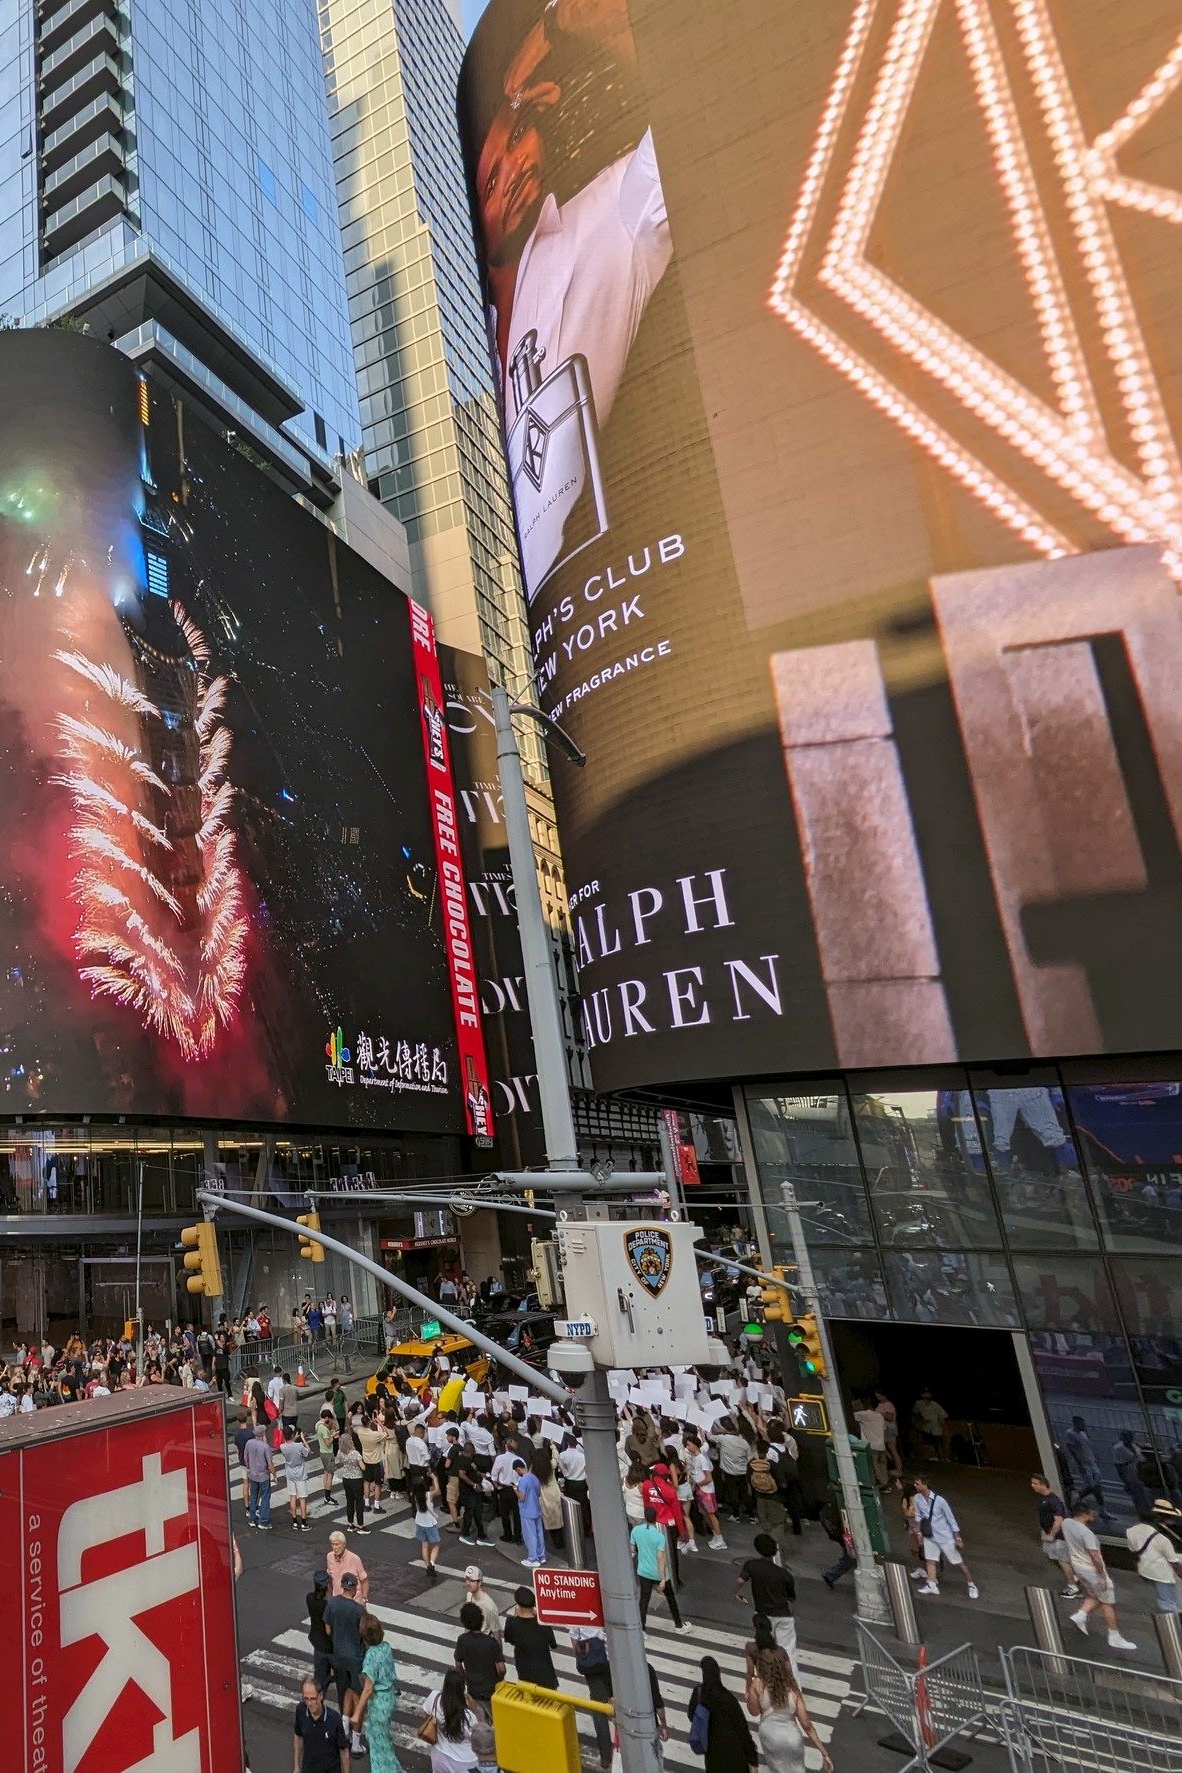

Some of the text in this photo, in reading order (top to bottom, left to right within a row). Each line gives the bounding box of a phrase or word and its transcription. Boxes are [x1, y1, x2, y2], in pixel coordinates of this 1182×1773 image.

[543, 476, 578, 514] LAUREN
[584, 534, 686, 602] CLUB
[562, 594, 645, 661] YORK
[565, 640, 672, 708] FRAGRANCE
[434, 788, 479, 1029] FREE CHOCOLATE
[579, 879, 601, 903] FOR
[575, 868, 736, 974] ALPH
[582, 954, 784, 1050] AUREN
[356, 1030, 448, 1085] 觀光傳播局
[359, 1074, 389, 1089] Department
[395, 1078, 422, 1093] Information
[421, 1082, 431, 1093] and
[431, 1084, 449, 1095] Tourism
[628, 1238, 669, 1251] DEPARTMENT
[634, 1230, 660, 1240] POLICE
[630, 1253, 671, 1289] CITY OF NEW YORK
[566, 1322, 592, 1336] NYPD
[28, 1513, 42, 1531] a
[28, 1541, 44, 1648] service
[537, 1573, 596, 1588] NO STANDING
[540, 1587, 577, 1600] Anytime
[30, 1658, 47, 1686] of
